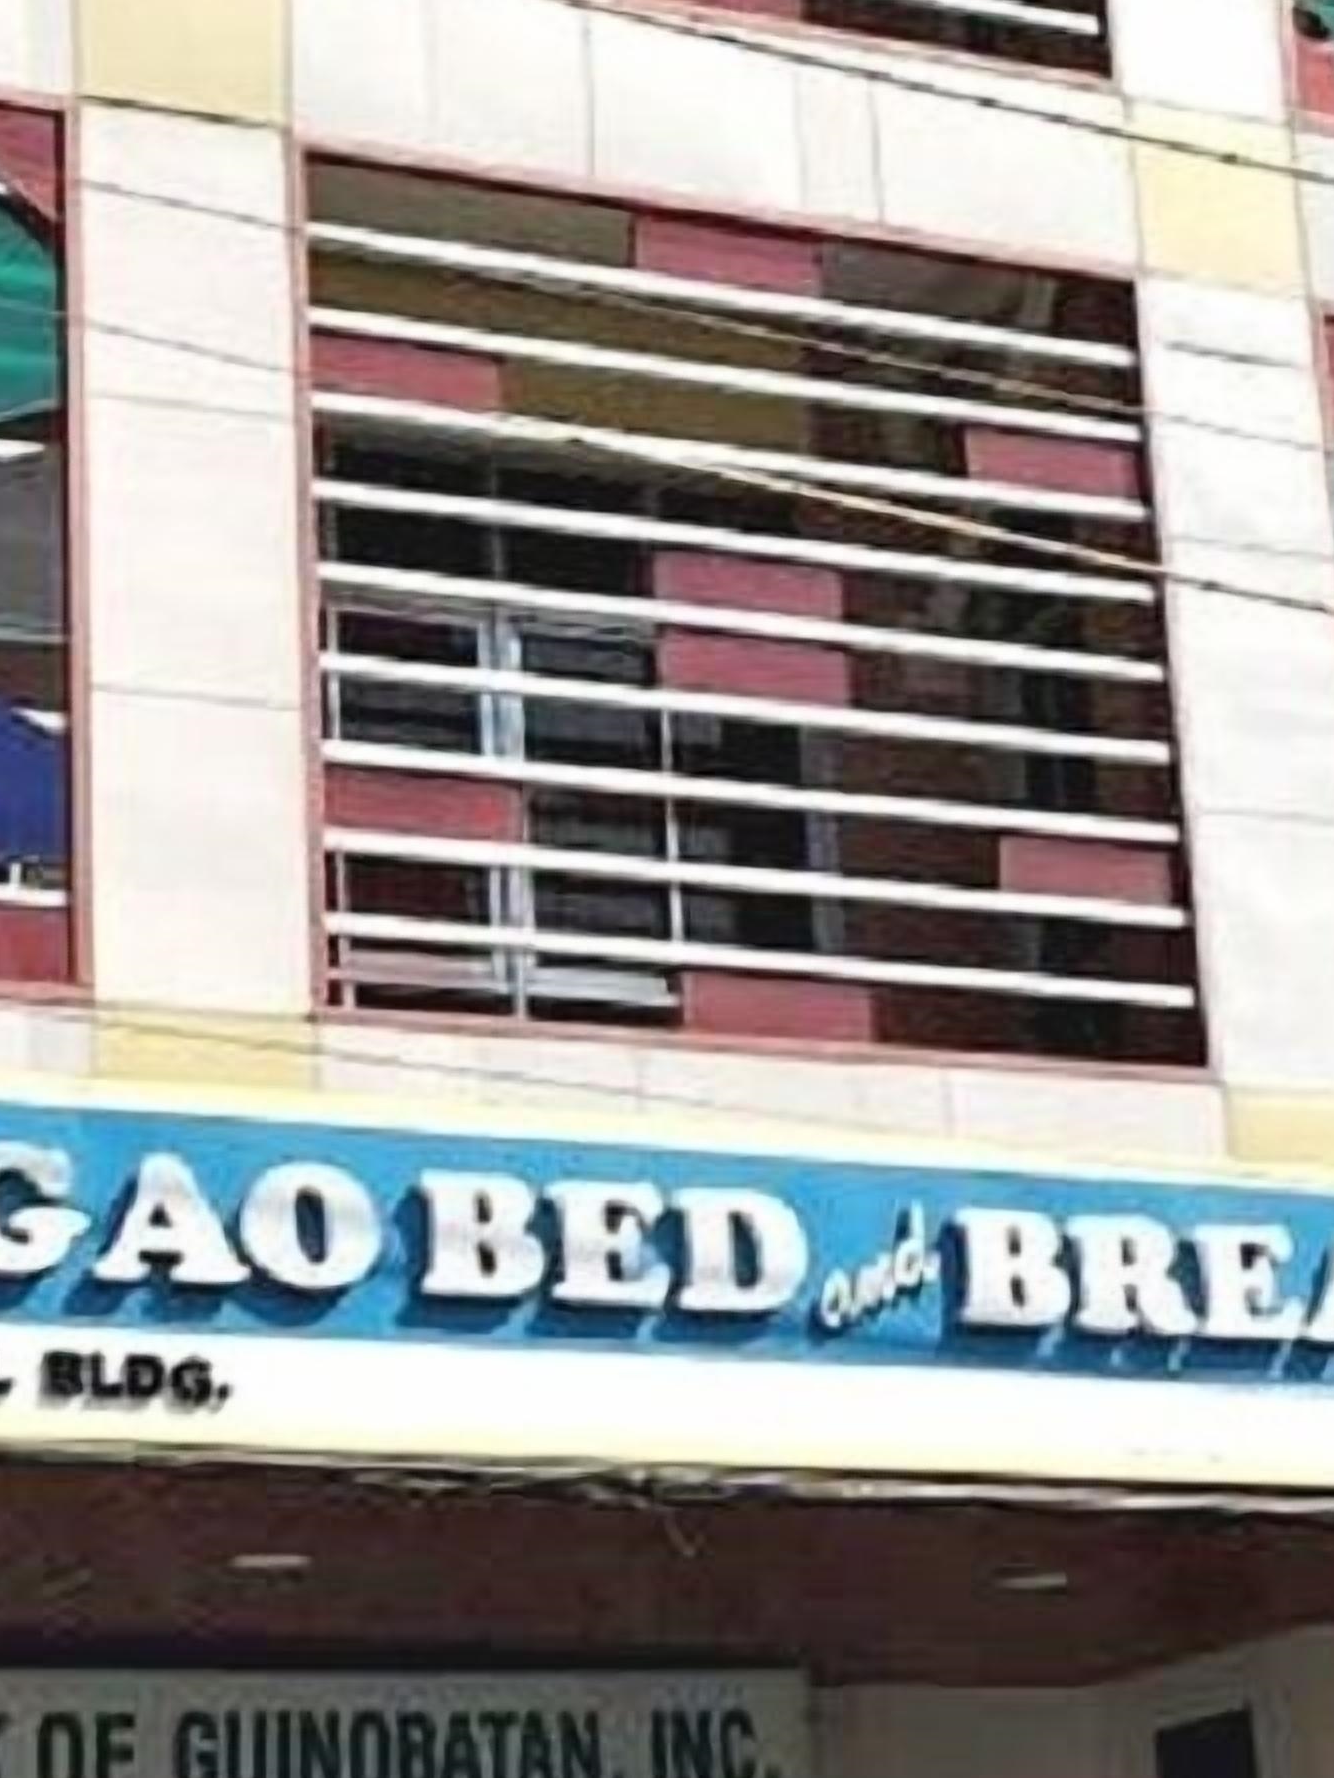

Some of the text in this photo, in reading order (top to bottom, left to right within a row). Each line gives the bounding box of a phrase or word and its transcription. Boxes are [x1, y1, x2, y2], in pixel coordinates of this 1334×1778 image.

[415, 1165, 809, 1316] BED
[820, 1200, 937, 1329] and
[39, 1348, 234, 1406] BLDG.
